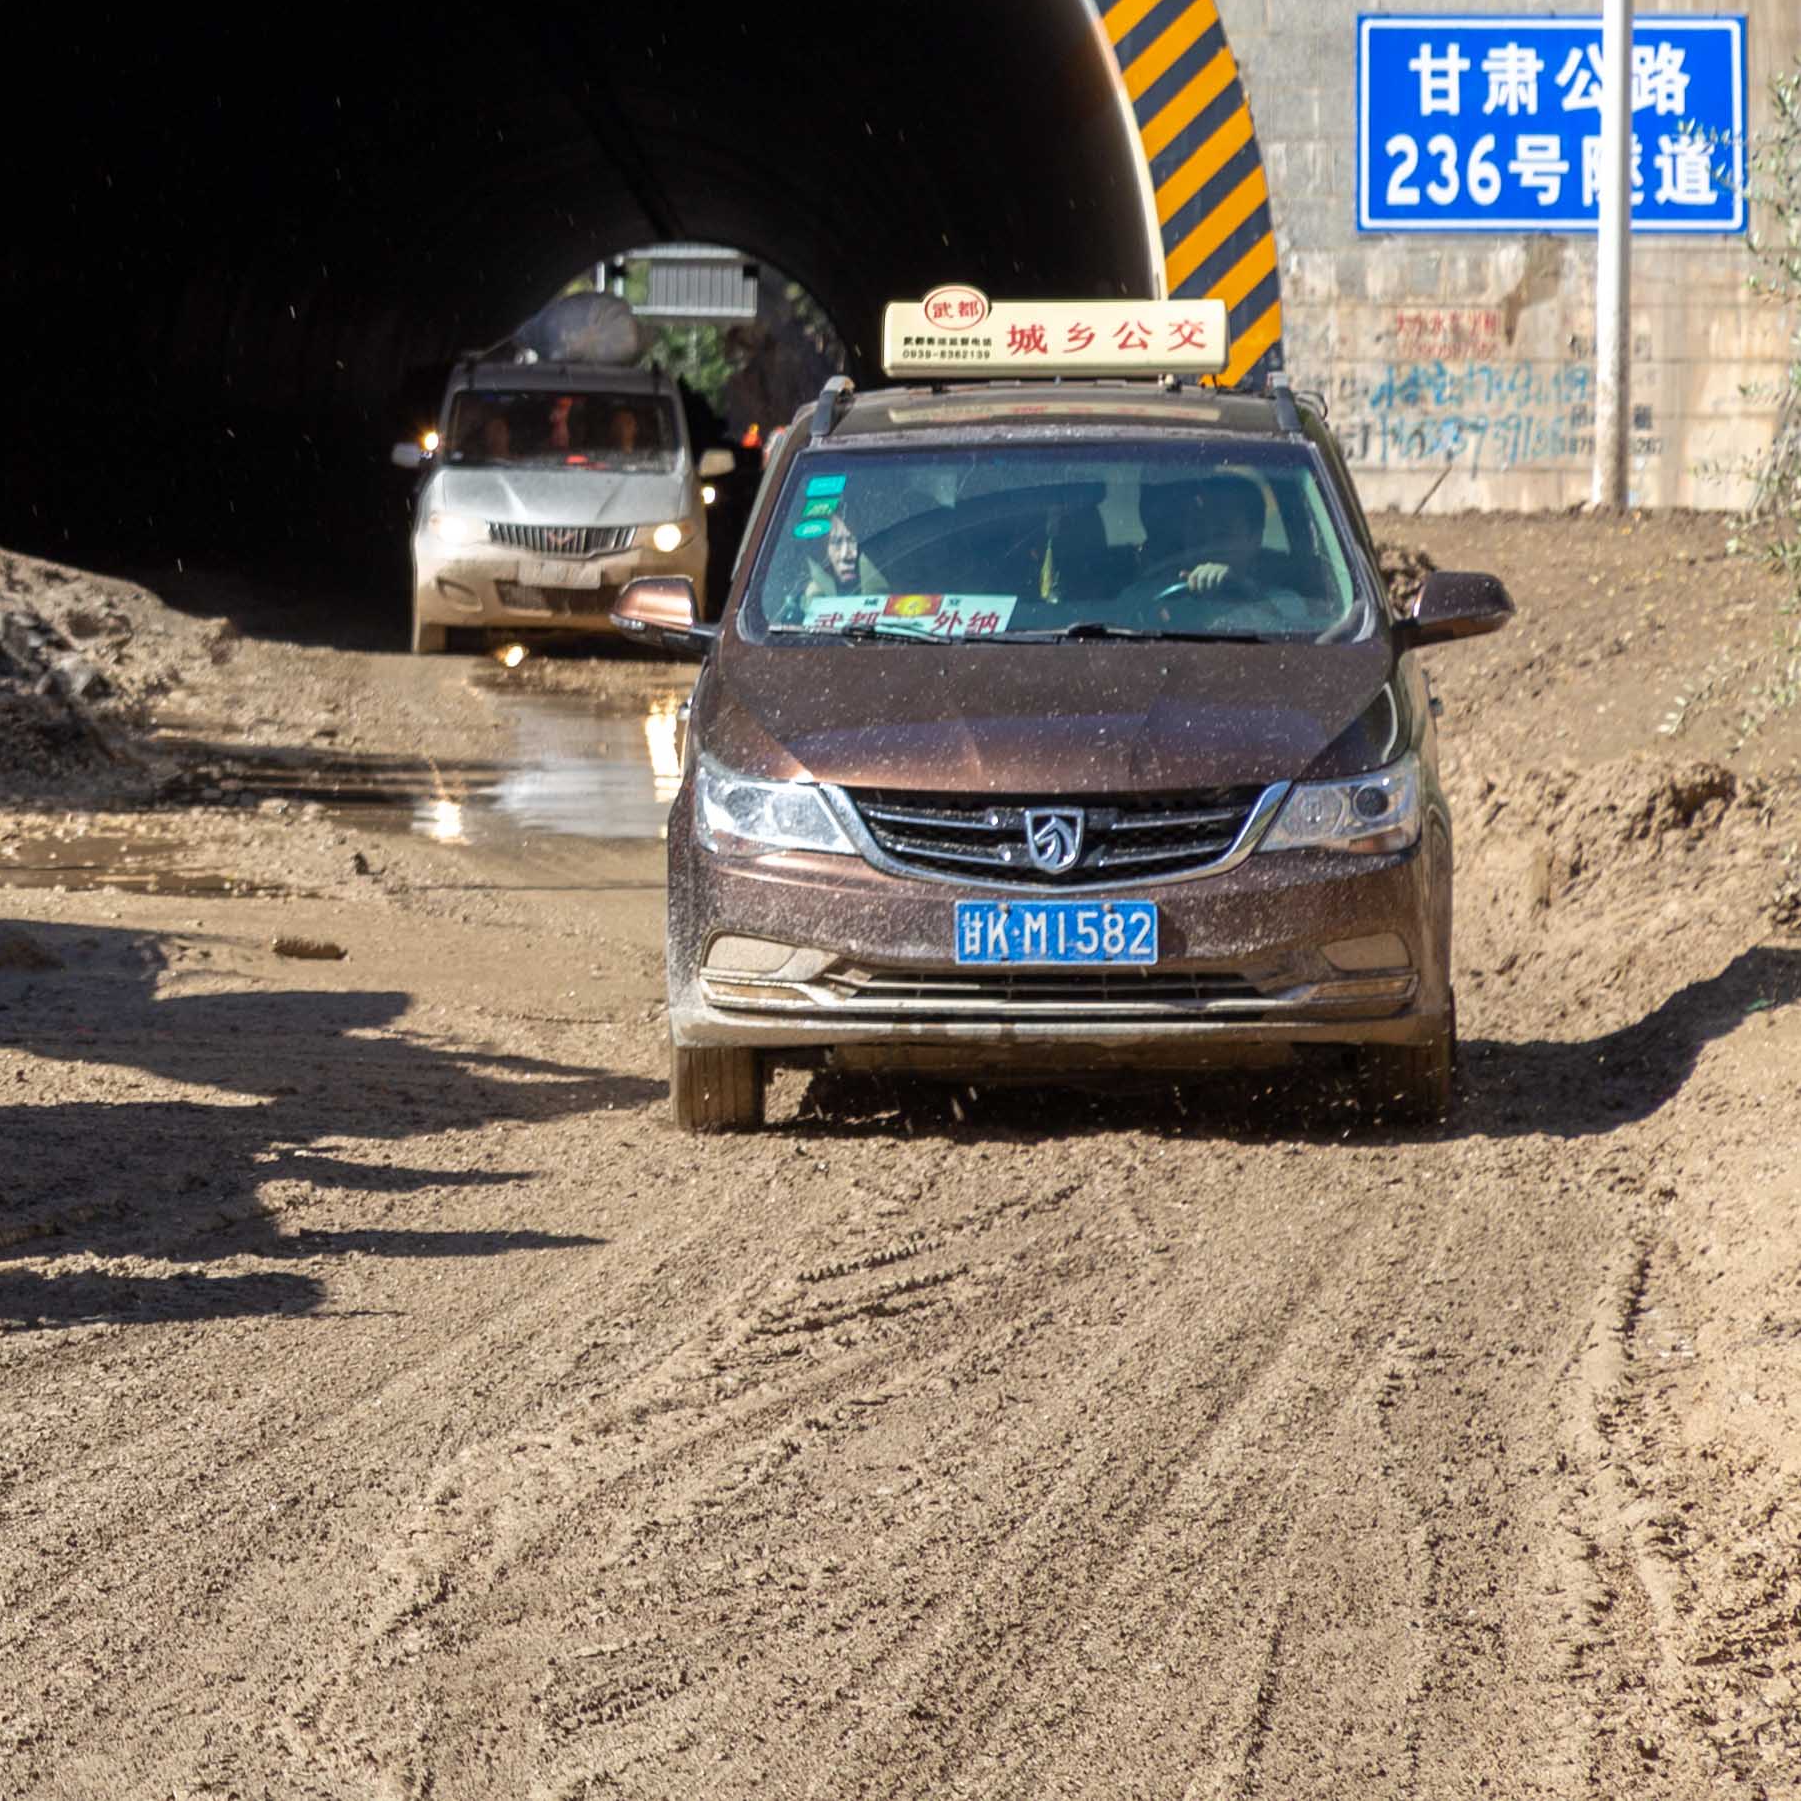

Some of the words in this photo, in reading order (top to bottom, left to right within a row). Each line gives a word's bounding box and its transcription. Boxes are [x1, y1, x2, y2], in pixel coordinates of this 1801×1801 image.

[1408, 41, 1691, 116] 甘肃公路
[932, 300, 980, 319] 武都
[1006, 319, 1207, 356] 城乡公交
